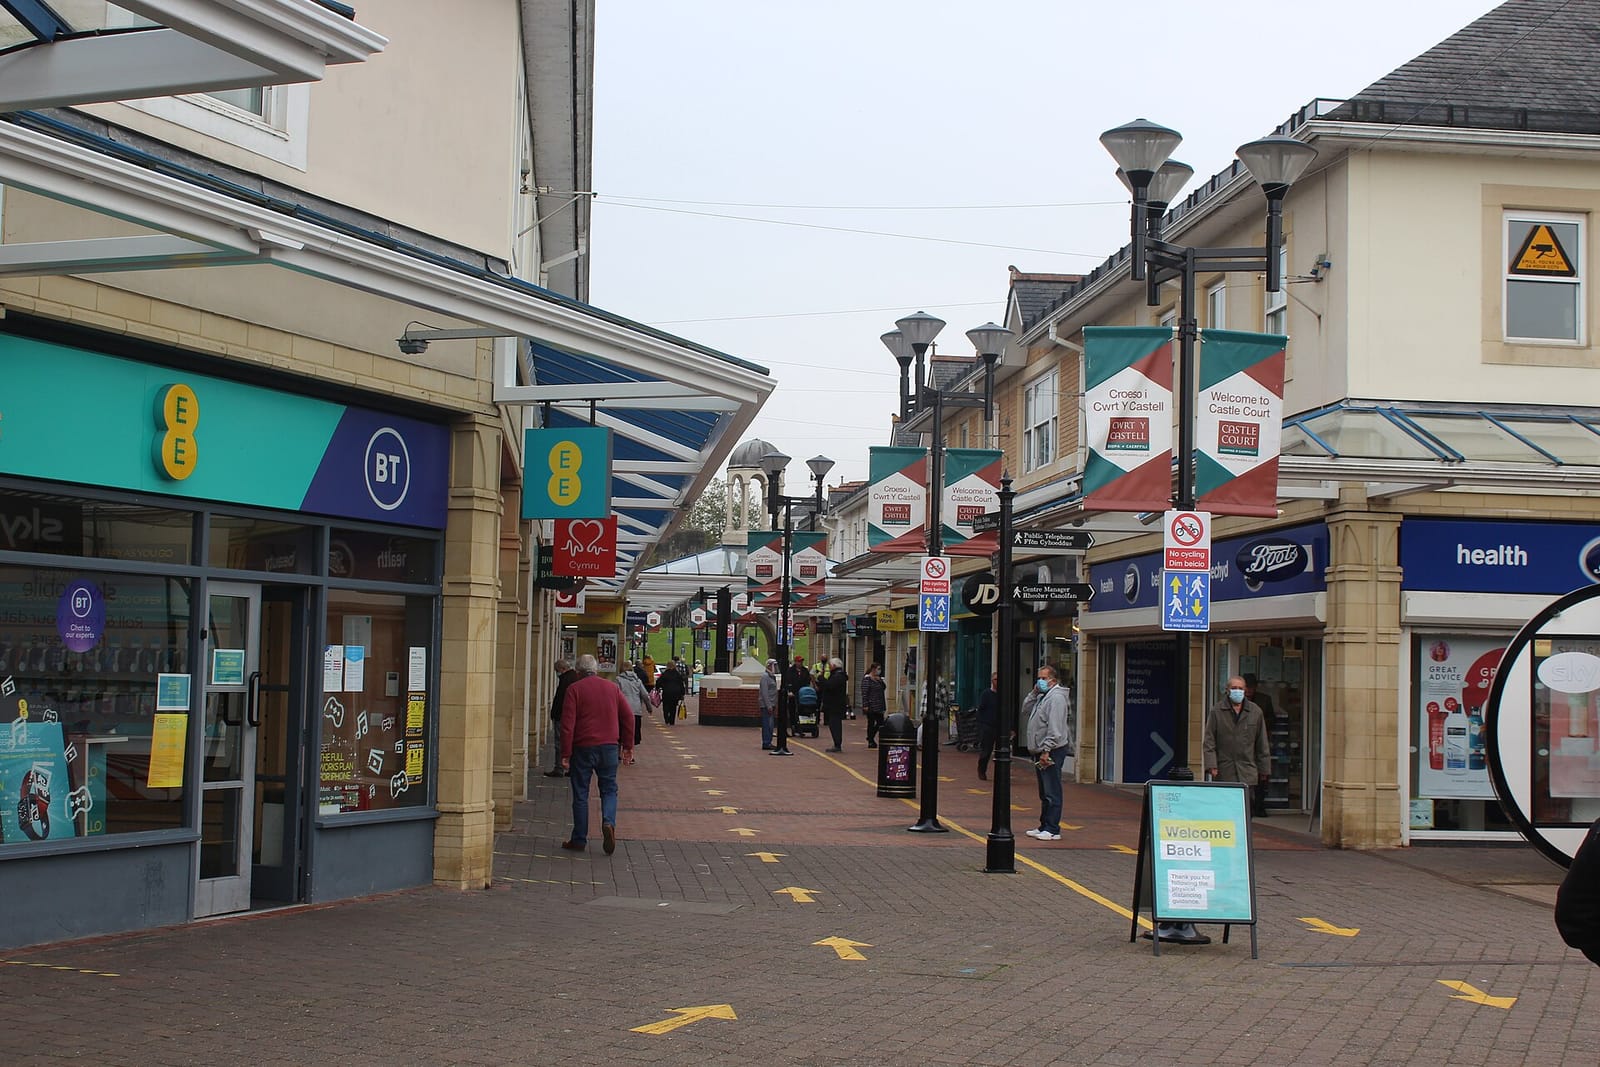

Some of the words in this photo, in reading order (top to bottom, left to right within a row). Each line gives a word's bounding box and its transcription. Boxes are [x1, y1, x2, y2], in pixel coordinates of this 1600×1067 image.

[1109, 388, 1143, 399] Croeso
[1144, 389, 1148, 399] i
[1210, 391, 1257, 405] Welcome
[1259, 395, 1270, 406] to
[1093, 401, 1119, 412] Cwrt
[1121, 401, 1129, 411] Y
[1129, 400, 1164, 412] Castell
[1208, 403, 1241, 416] Castle
[1242, 406, 1271, 418] Court
[1112, 421, 1136, 430] CWRT
[1140, 421, 1146, 429] Y
[1221, 424, 1257, 436] CASTLE
[1110, 432, 1147, 440] CASTELL
[1221, 434, 1257, 446] COURT
[375, 452, 401, 485] BT
[883, 485, 907, 493] Croeso
[952, 487, 982, 495] Welcome
[897, 493, 921, 501] Castell
[950, 494, 973, 503] Castle
[973, 495, 993, 503] Court
[1044, 533, 1075, 541] Telephone
[1180, 551, 1206, 559] cycling
[1246, 544, 1299, 573] Boots
[1456, 543, 1528, 567] health
[568, 560, 600, 571] Cymru
[1169, 559, 1183, 567] Dim
[1184, 560, 1206, 568] beicio
[1100, 577, 1114, 593] health
[970, 583, 1000, 605] JD
[75, 597, 88, 609] BT
[70, 623, 83, 632] Chat
[84, 624, 92, 632] to
[65, 631, 75, 639] our
[75, 632, 95, 640] experts
[1428, 665, 1457, 673] GREAT
[1551, 654, 1598, 688] sky
[1127, 687, 1149, 696] photo
[1126, 697, 1160, 705] electrical
[1165, 825, 1232, 840] Welcome
[1166, 843, 1203, 857] Back
[1171, 879, 1198, 888] following
